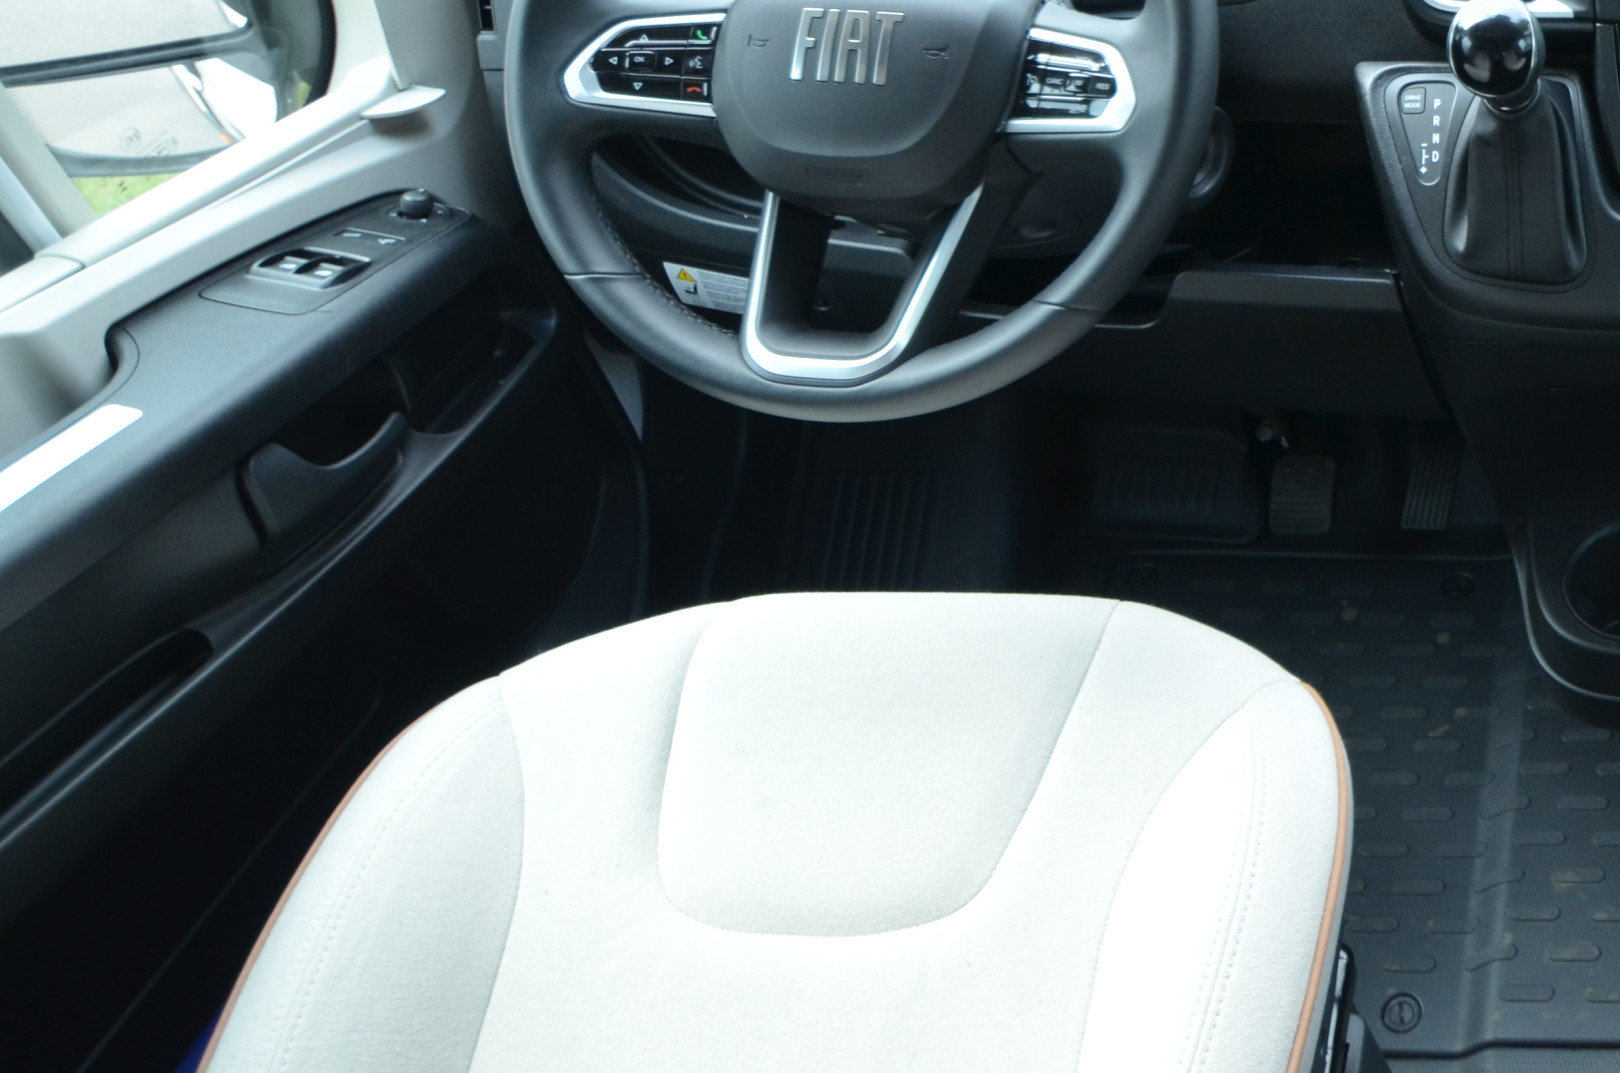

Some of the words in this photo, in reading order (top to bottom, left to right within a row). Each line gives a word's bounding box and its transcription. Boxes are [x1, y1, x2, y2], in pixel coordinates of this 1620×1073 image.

[789, 7, 905, 86] FIAT
[1433, 98, 1442, 109] P
[1432, 115, 1440, 127] R
[1432, 133, 1440, 144] N
[1431, 150, 1439, 163] D
